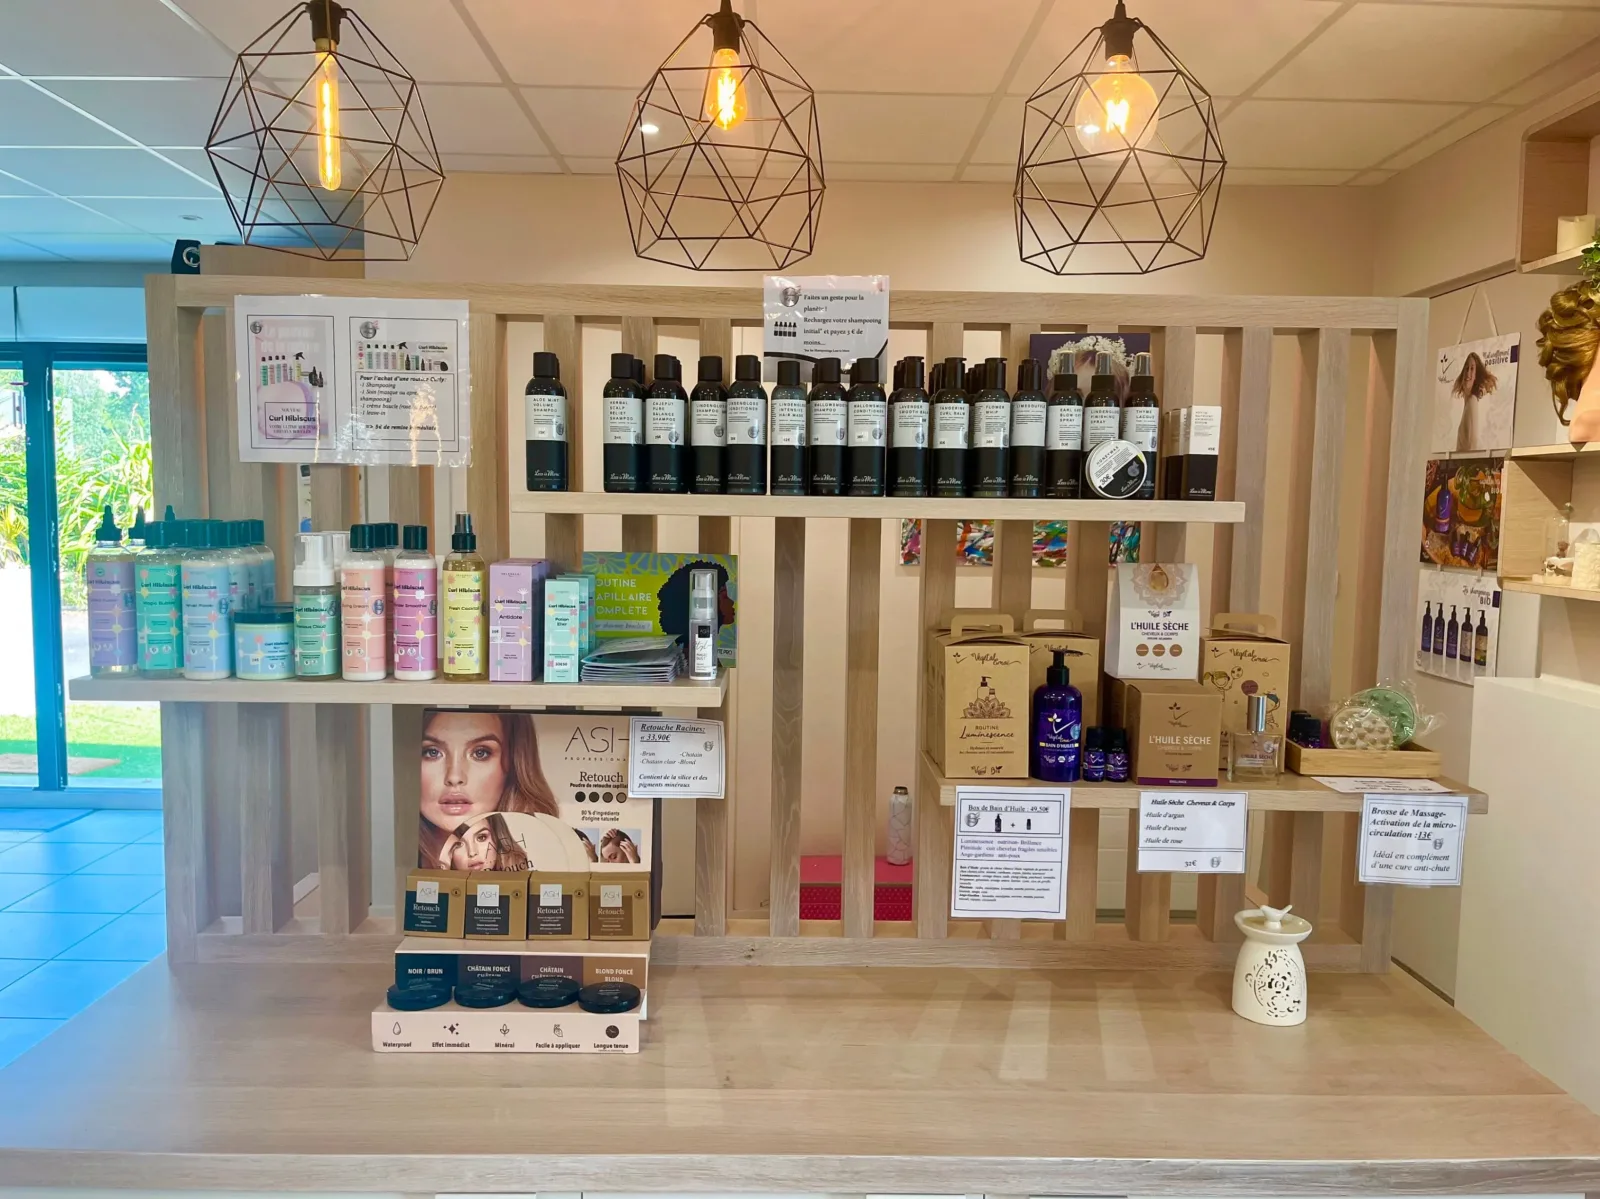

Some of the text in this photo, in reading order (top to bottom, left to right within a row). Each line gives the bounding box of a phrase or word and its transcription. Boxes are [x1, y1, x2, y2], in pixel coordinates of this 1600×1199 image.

[1099, 473, 1112, 486] 30€
[596, 578, 636, 588] OUTINE
[596, 592, 652, 601] APILLAIRE
[596, 606, 648, 615] OMPLETE
[1131, 621, 1189, 631] L'HUILE SÈCHE
[641, 724, 706, 734] Retouche Racines:
[959, 726, 1015, 739] Luminescence
[647, 734, 670, 742] 33,90€
[1149, 735, 1212, 745] L'HUILE SÈCHE
[580, 771, 624, 782] Retouch
[1163, 812, 1185, 820] d'argan
[1372, 807, 1397, 816] Brosse
[1411, 810, 1447, 819] Massage-
[1370, 819, 1410, 827] Activation
[1413, 820, 1422, 828] de
[1369, 830, 1412, 838] circulation
[1373, 851, 1393, 859] Idéal
[1407, 853, 1450, 862] complément
[1371, 862, 1394, 870] d'une
[1414, 864, 1450, 872] anti-chute
[413, 904, 440, 912] Retouch
[474, 907, 501, 916] Retouch
[537, 907, 564, 915] Retouch
[598, 908, 625, 916] Retouch
[540, 966, 564, 974] CHÂTAIN
[615, 967, 634, 975] FONCÉ
[555, 1043, 580, 1051] appliquer
